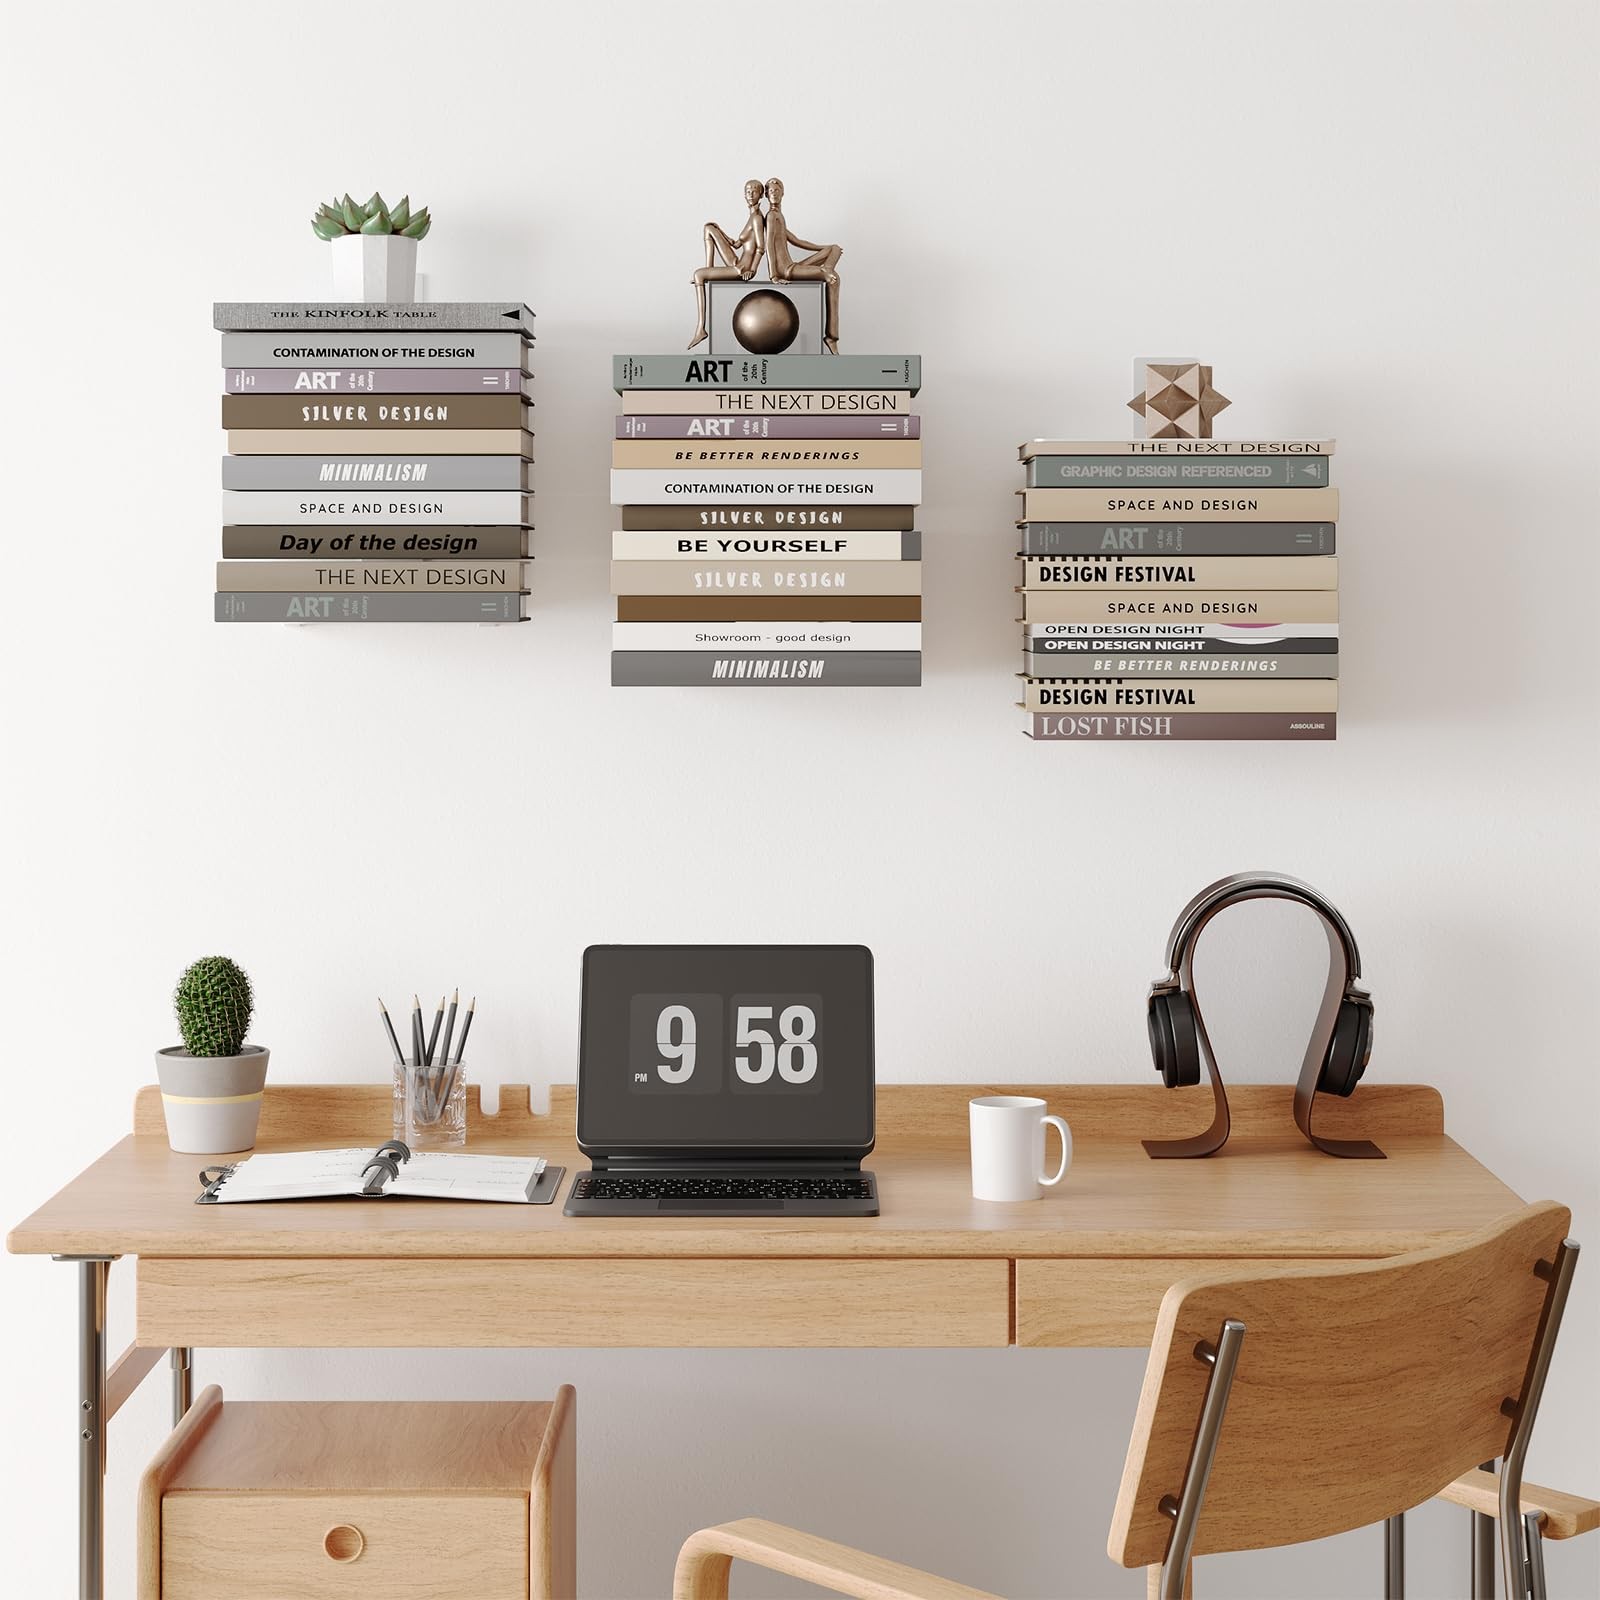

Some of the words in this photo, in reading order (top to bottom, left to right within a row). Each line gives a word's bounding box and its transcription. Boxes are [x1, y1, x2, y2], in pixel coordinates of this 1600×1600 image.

[305, 310, 389, 318] KINFOLK
[273, 348, 378, 358] CONTAMINATION
[382, 348, 398, 358] OF
[402, 348, 425, 358] THE
[429, 348, 475, 358] DESIGN
[685, 361, 733, 382] ART
[742, 373, 748, 382] of
[761, 359, 769, 385] Century
[295, 373, 341, 389] ART
[716, 395, 753, 410] THE
[762, 395, 814, 410] NEXT
[822, 394, 896, 410] DESIGN
[302, 406, 368, 422] SILVER
[379, 406, 448, 422] DESIGN
[688, 419, 734, 436] ART
[1128, 443, 1168, 453] THE
[1177, 443, 1232, 453] NEXT
[1241, 443, 1320, 453] DESIGN
[675, 452, 693, 460] BE
[700, 452, 754, 460] BETTER
[762, 452, 860, 460] RENDERINGS
[319, 464, 428, 481] MINIMALISM
[1061, 466, 1122, 477] GRAPHIC
[1127, 466, 1177, 477] DESIGN
[1182, 466, 1272, 477] REFERENCED
[665, 484, 774, 494] CONTAMINATION
[777, 484, 795, 494] OF
[798, 484, 822, 494] THE
[825, 484, 873, 494] DESIGN
[300, 503, 345, 514] SPACE
[352, 503, 382, 514] AND
[389, 503, 443, 514] DESIGN
[1108, 500, 1155, 511] SPACE
[1162, 500, 1194, 511] AND
[1202, 500, 1258, 511] DESIGN
[700, 511, 764, 525] SILVER
[776, 511, 843, 525] DESIGN
[280, 535, 323, 554] Day
[330, 534, 355, 551] of
[360, 535, 396, 551] the
[403, 534, 478, 554] design
[1101, 528, 1148, 549] ART
[678, 540, 708, 552] BE
[717, 540, 847, 552] YOURSELF
[316, 569, 355, 585] THE
[364, 569, 419, 585] NEXT
[427, 569, 505, 585] DESIGN
[694, 573, 762, 588] SILVER
[774, 573, 846, 588] DESIGN
[1040, 567, 1107, 582] DESIGN
[1116, 567, 1195, 582] FESTIVAL
[287, 597, 334, 617] ART
[1108, 603, 1155, 614] SPACE
[1162, 603, 1194, 614] AND
[1202, 603, 1258, 614] DESIGN
[1045, 626, 1088, 634] OPEN
[1093, 626, 1152, 634] DESIGN
[1156, 626, 1205, 634] NIGHT
[696, 634, 761, 642] Showroom
[776, 634, 806, 644] good
[810, 633, 851, 644] design
[1045, 641, 1089, 650] OPEN
[1093, 641, 1152, 650] DESIGN
[1155, 641, 1206, 650] NIGHT
[712, 660, 824, 679] MINIMALISM
[1094, 661, 1112, 671] BE
[1118, 661, 1173, 671] BETTER
[1179, 660, 1278, 671] RENDERINGS
[1040, 689, 1107, 705] DESIGN
[1116, 689, 1195, 705] FESTIVAL
[1042, 717, 1108, 736] LOST
[1115, 717, 1172, 736] FISH
[656, 1005, 697, 1084] 9
[735, 1005, 818, 1084] 58
[635, 1073, 647, 1082] PM
